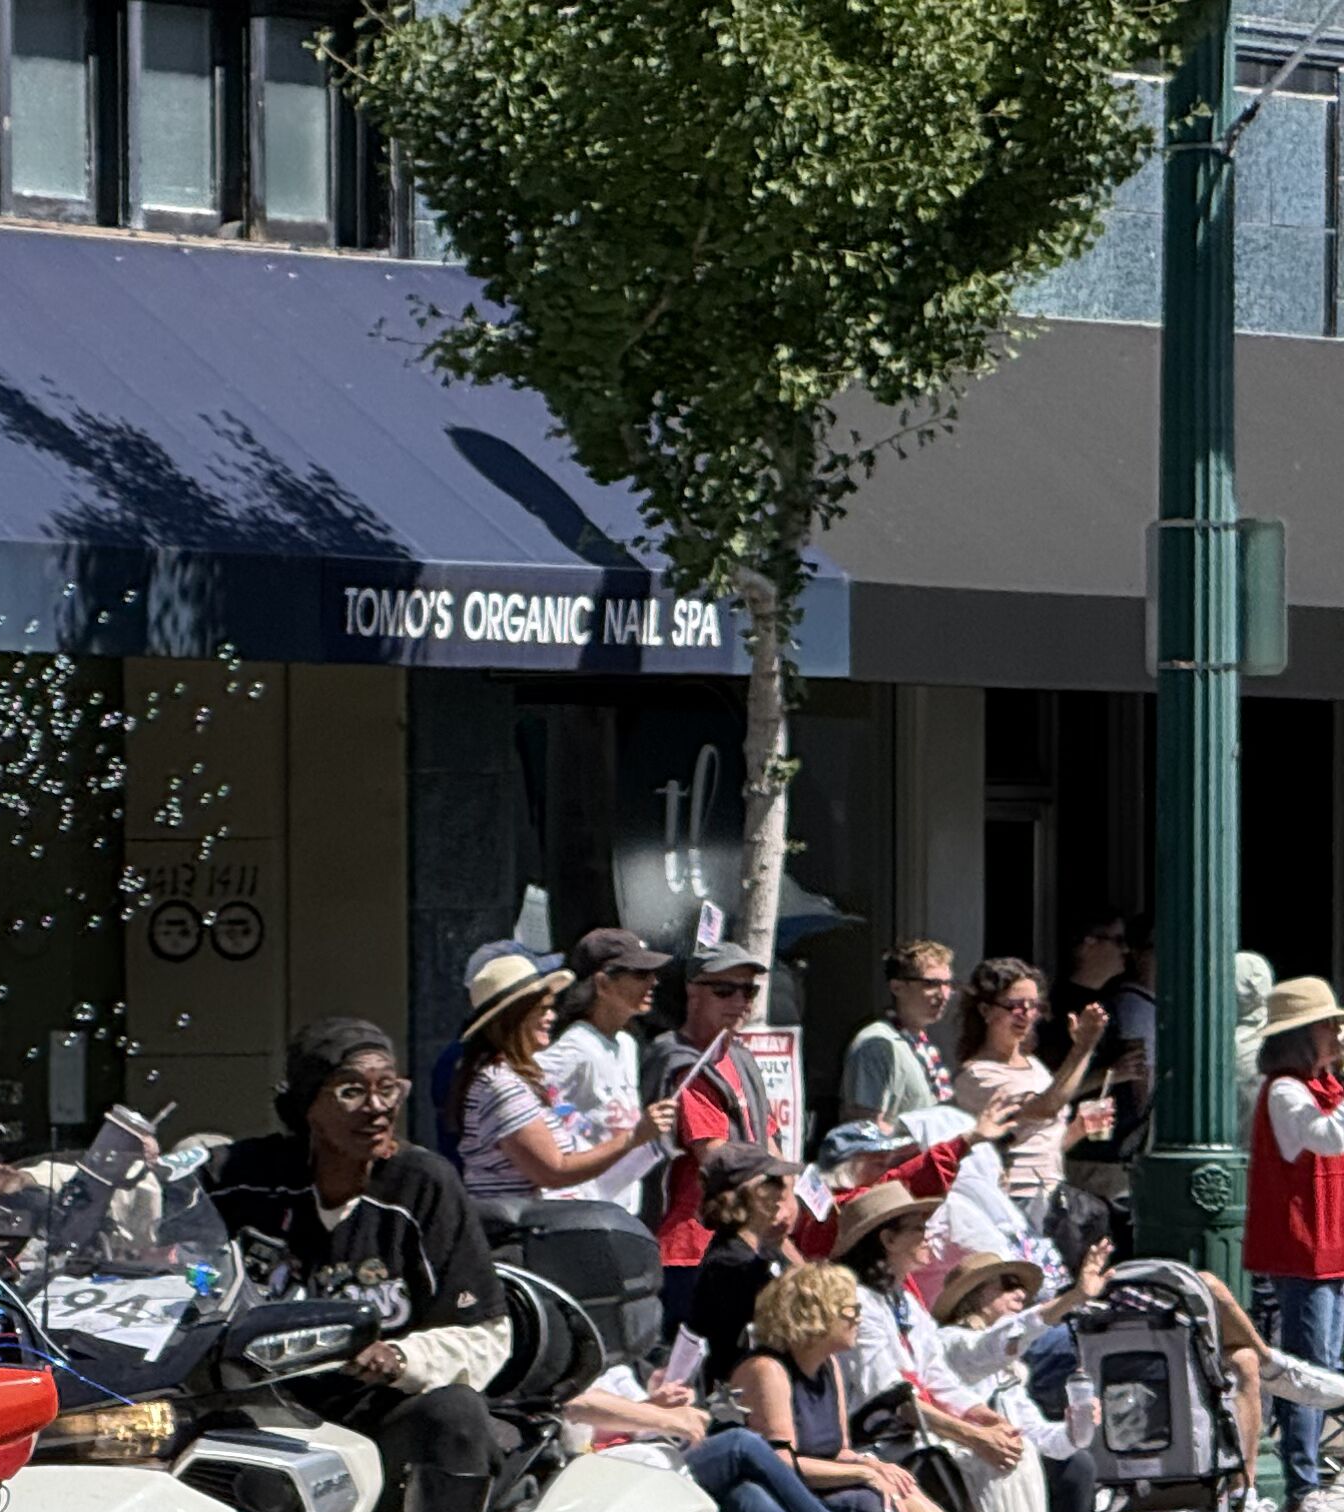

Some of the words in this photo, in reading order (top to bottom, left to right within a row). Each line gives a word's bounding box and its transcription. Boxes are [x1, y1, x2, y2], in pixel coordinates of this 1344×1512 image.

[344, 586, 454, 640] TOMO'S
[463, 591, 596, 646] ORGANIC
[602, 597, 664, 647] NAIL
[671, 597, 722, 648] SPA
[55, 1287, 151, 1328] 94
